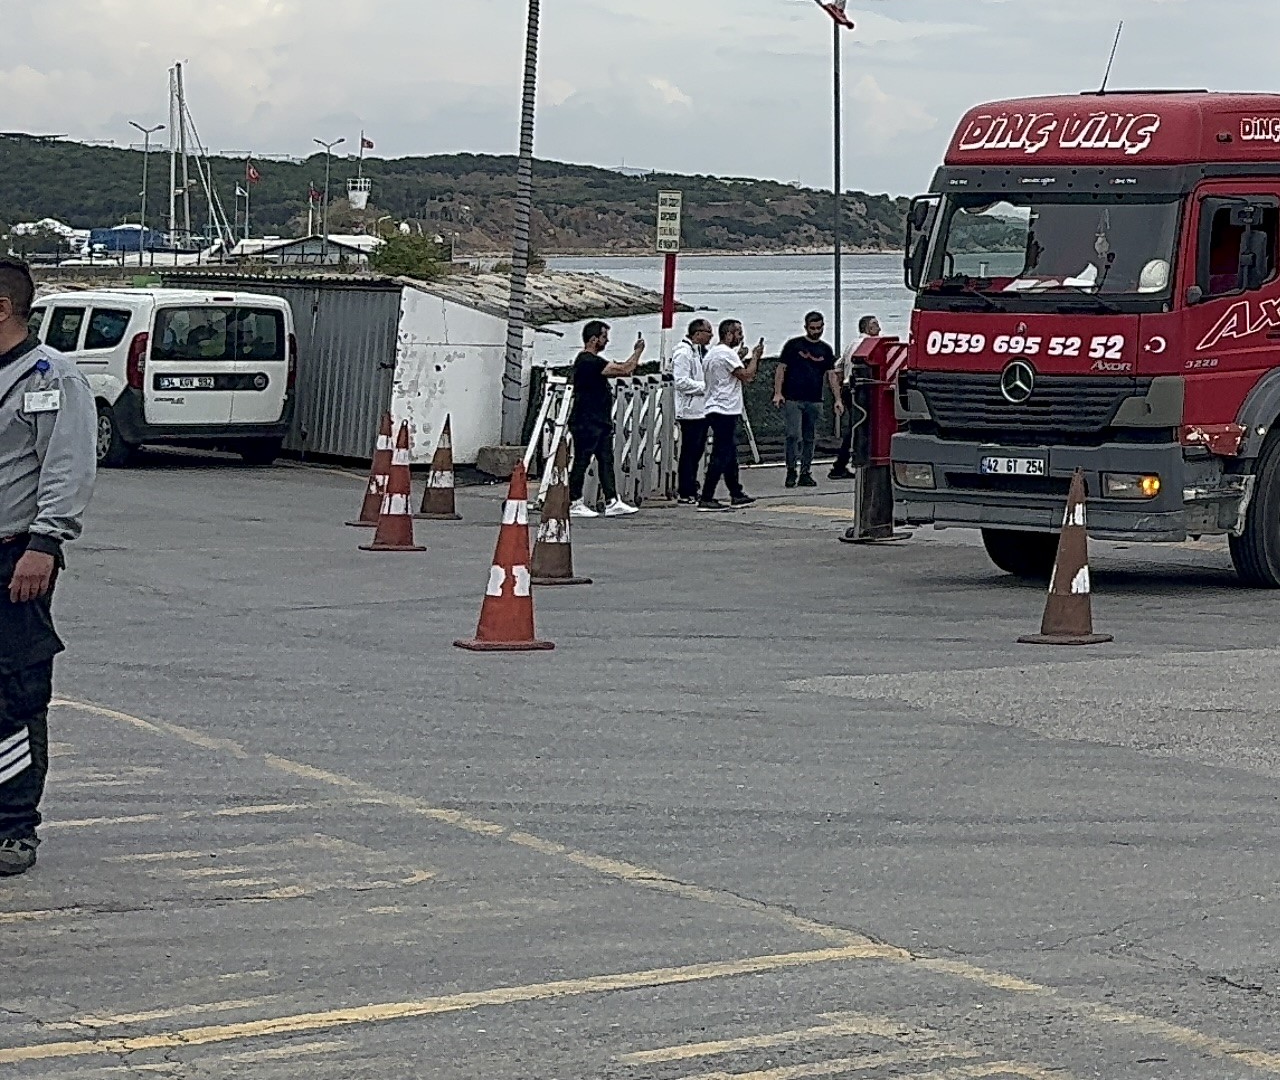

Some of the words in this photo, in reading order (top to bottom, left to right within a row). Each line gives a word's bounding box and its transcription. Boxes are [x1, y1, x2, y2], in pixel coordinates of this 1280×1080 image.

[958, 112, 1055, 154] DİNÇ
[1059, 112, 1161, 155] VİNÇ
[926, 331, 985, 355] 0539
[993, 334, 1042, 355] 695
[1047, 336, 1080, 357] 52
[1088, 334, 1125, 359] 52
[987, 458, 999, 472] 42
[1026, 460, 1043, 474] 254
